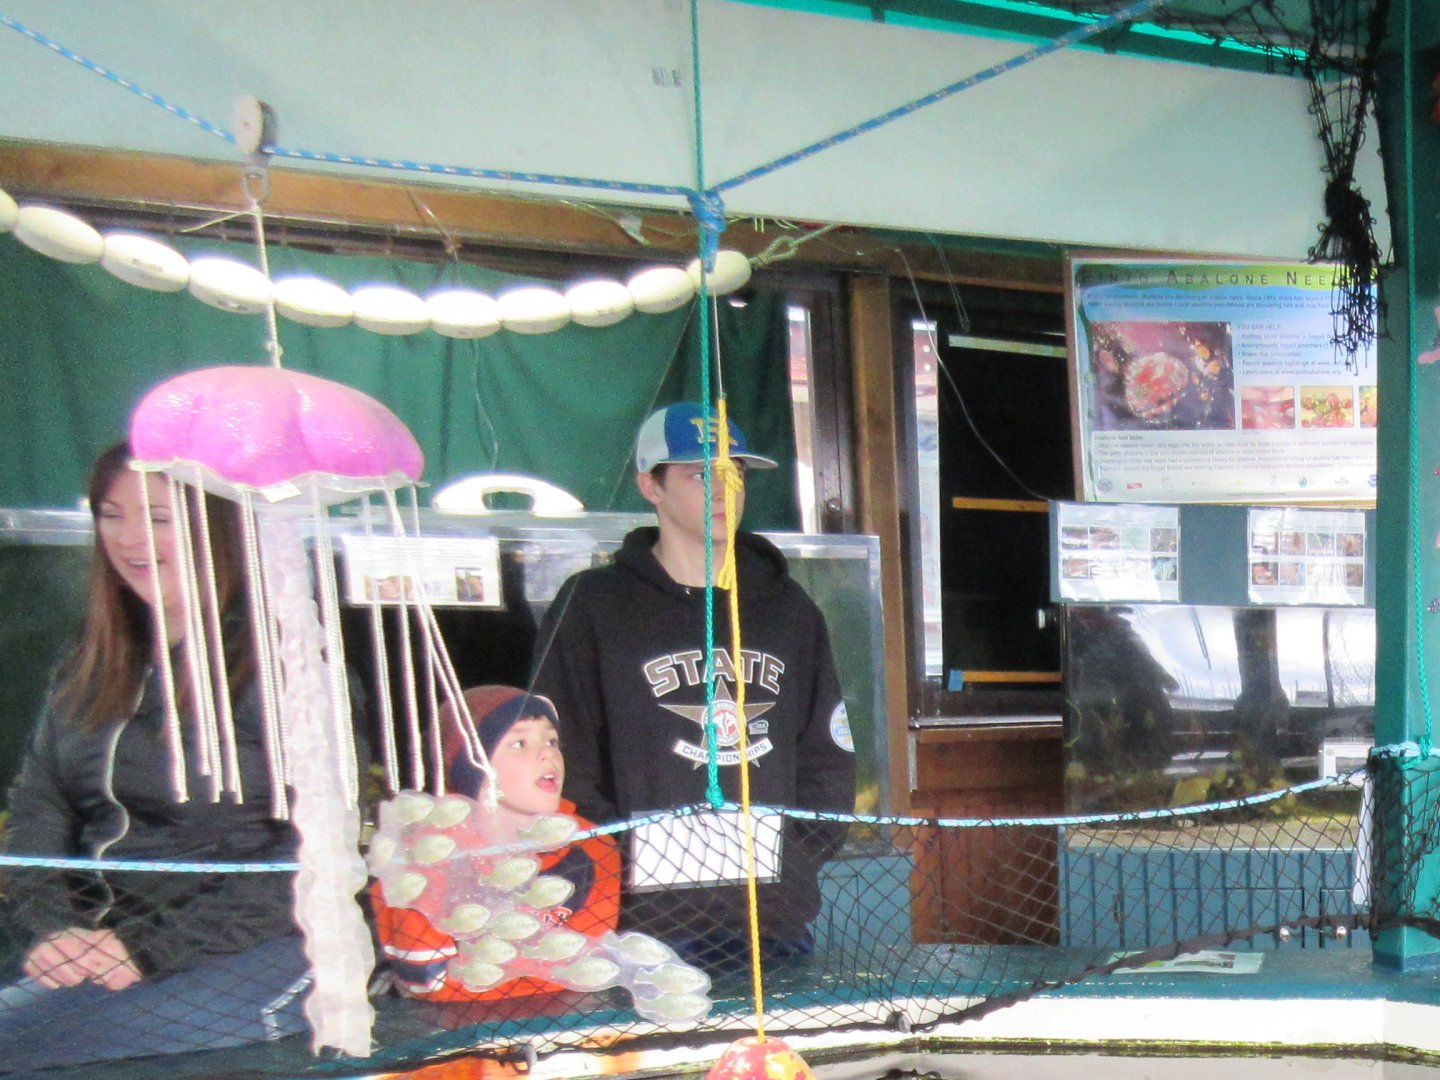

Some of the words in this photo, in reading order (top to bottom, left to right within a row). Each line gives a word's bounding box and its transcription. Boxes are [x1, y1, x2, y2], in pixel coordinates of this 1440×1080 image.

[1167, 269, 1269, 286] ABALONE
[643, 648, 785, 698] STATE
[682, 742, 768, 763] CHAPIONHIPS
